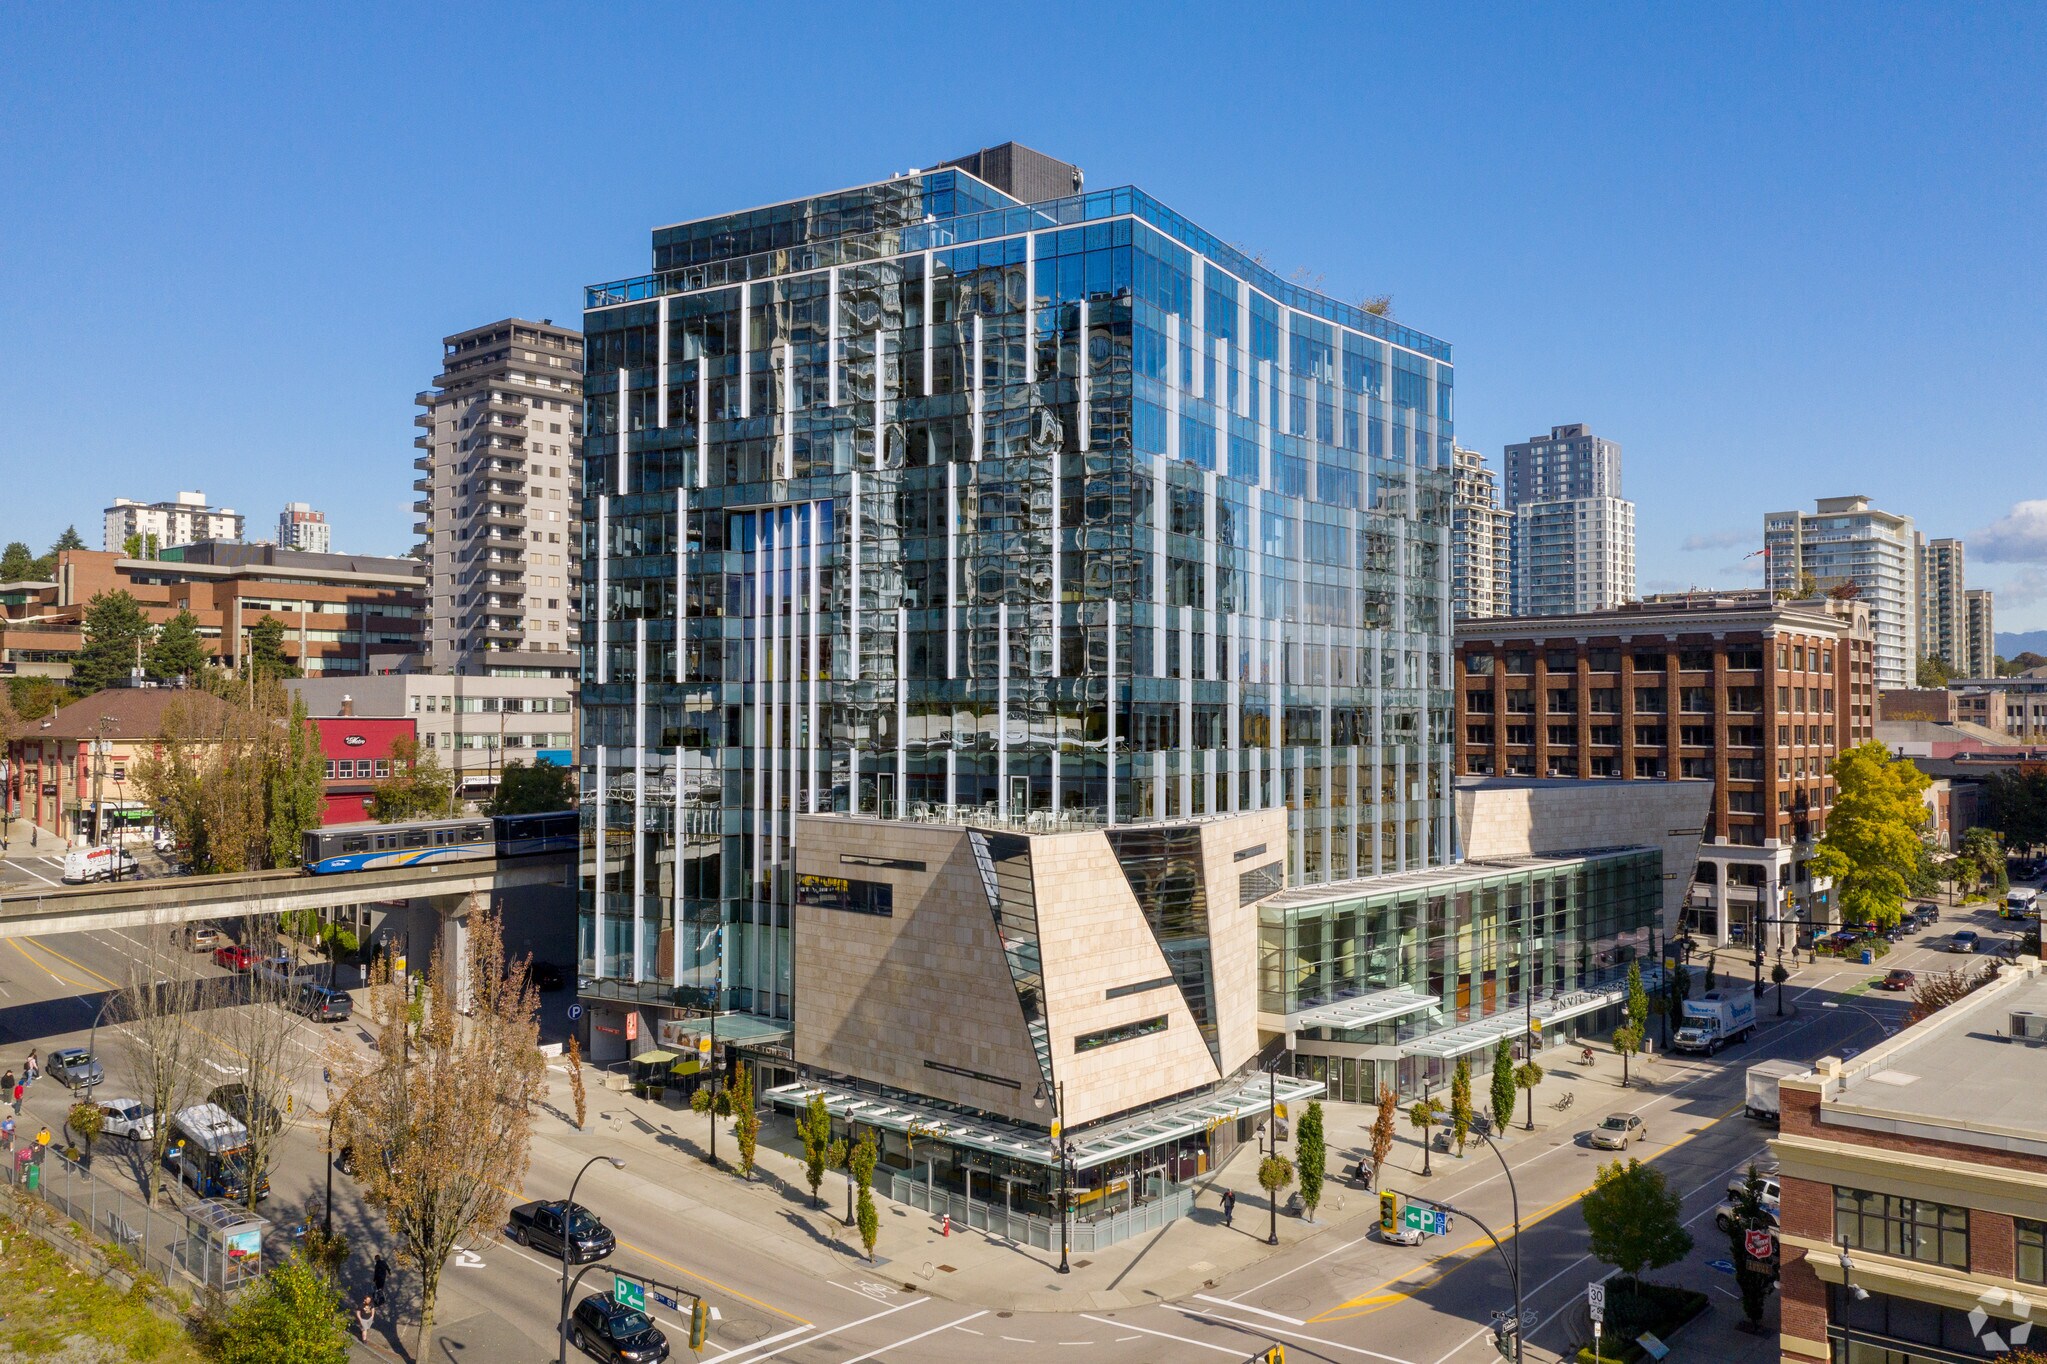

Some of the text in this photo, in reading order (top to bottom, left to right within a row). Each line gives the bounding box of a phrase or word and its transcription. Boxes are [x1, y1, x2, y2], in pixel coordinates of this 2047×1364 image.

[762, 1046, 789, 1058] TOWER
[1420, 1210, 1434, 1230] P
[617, 1280, 627, 1299] P
[1590, 1288, 1603, 1302] 30
[666, 1299, 676, 1308] ST
